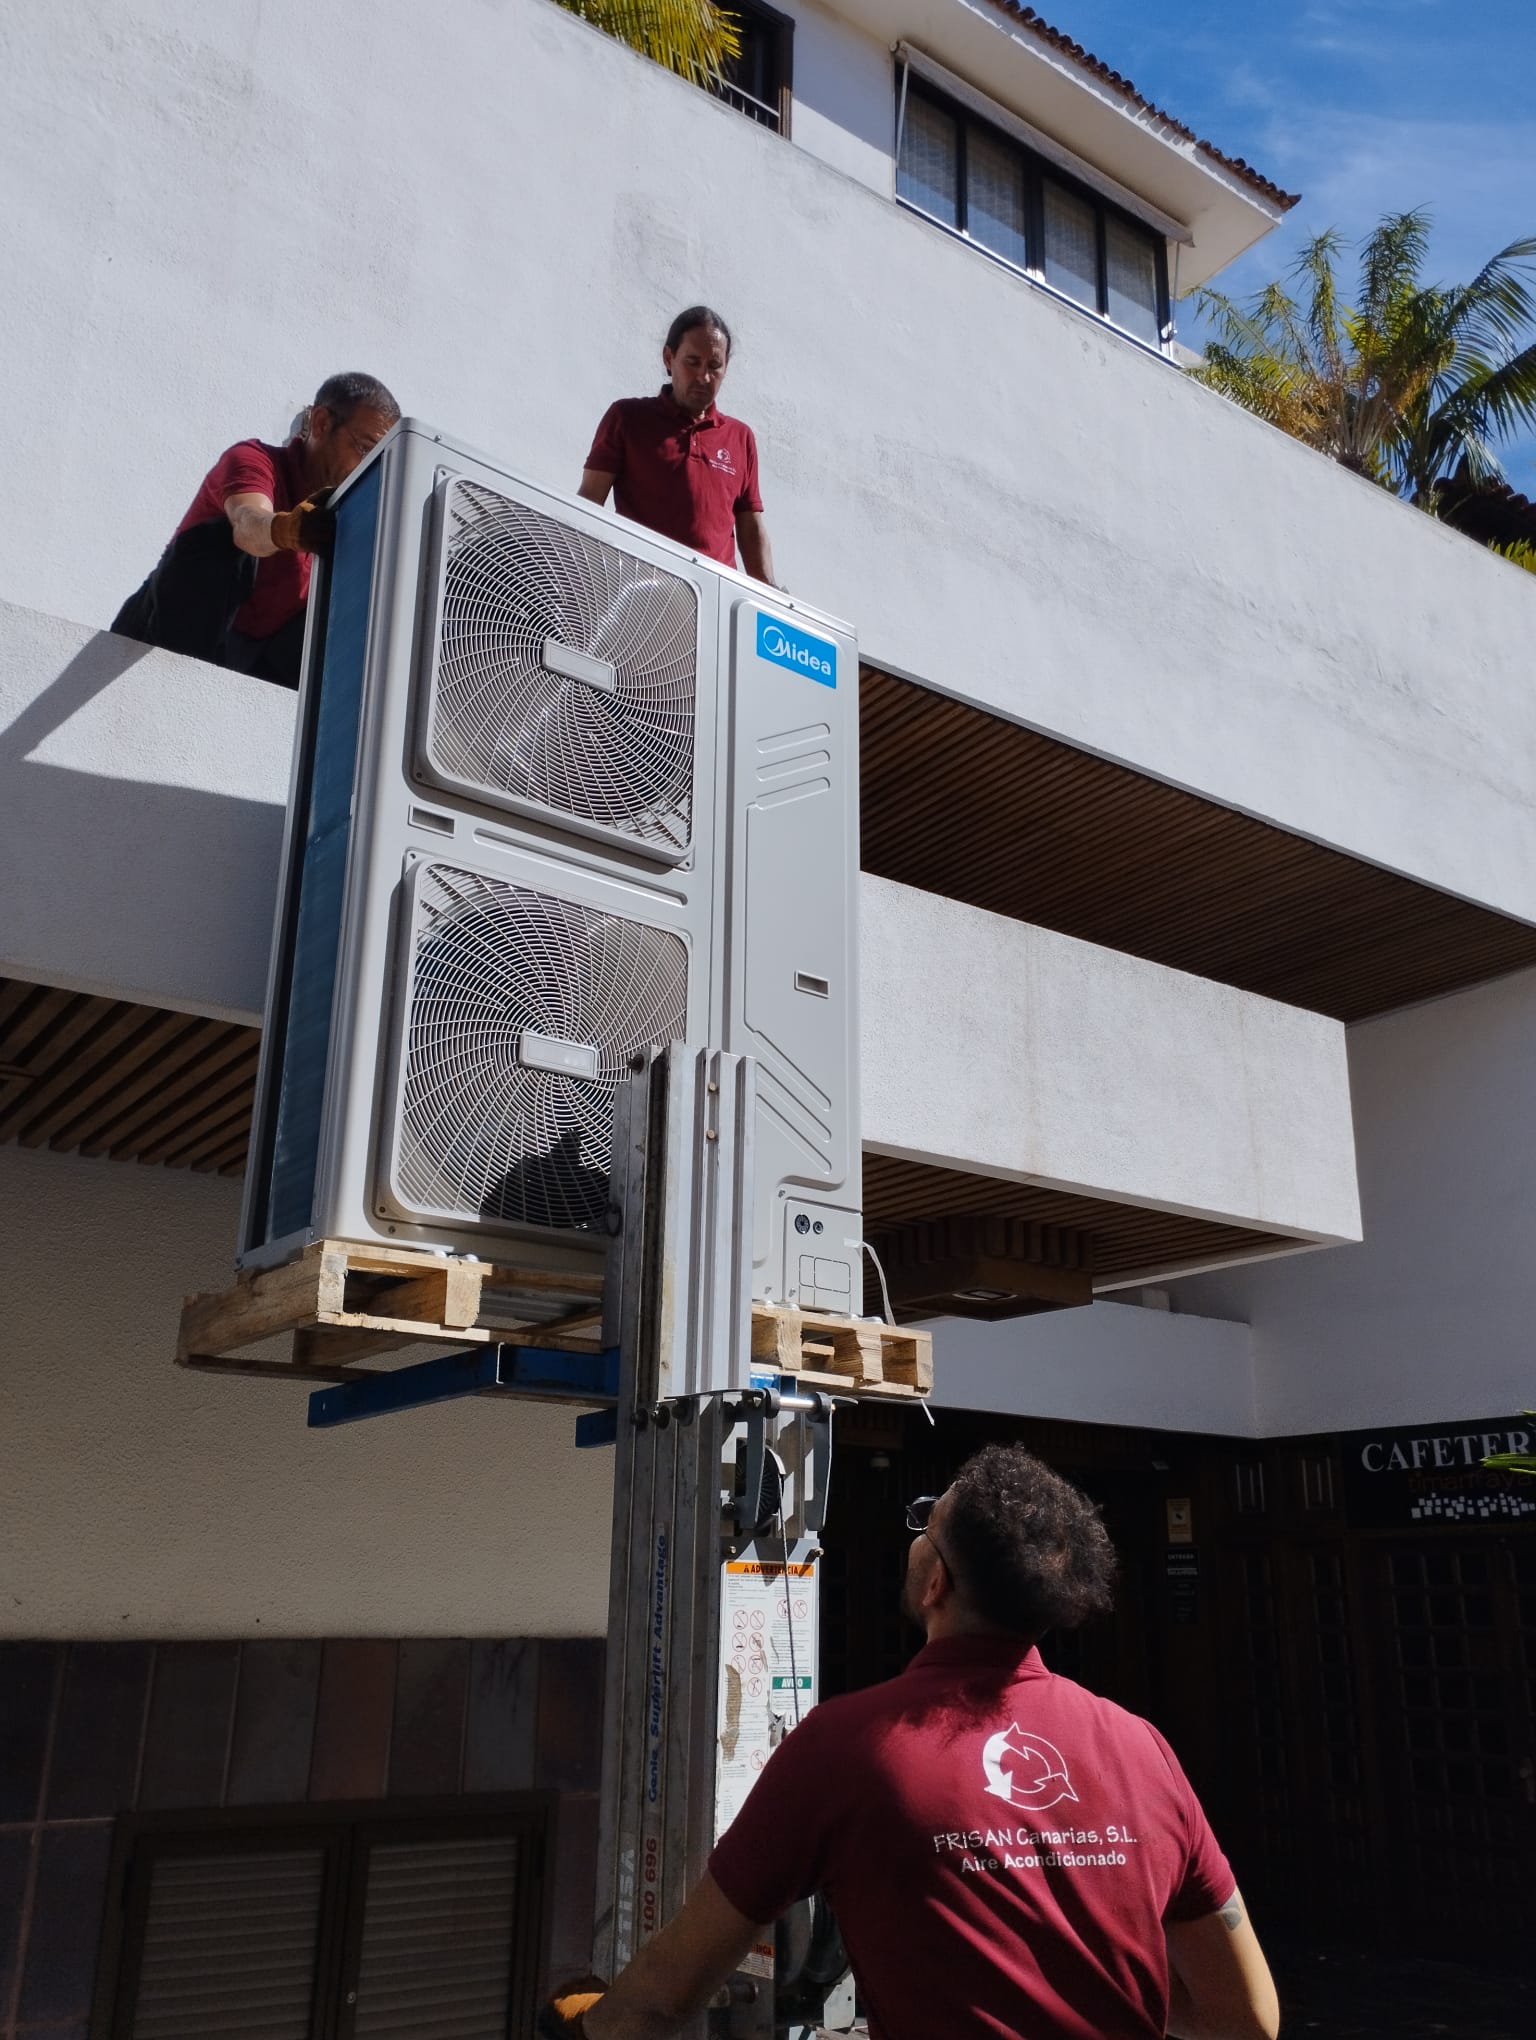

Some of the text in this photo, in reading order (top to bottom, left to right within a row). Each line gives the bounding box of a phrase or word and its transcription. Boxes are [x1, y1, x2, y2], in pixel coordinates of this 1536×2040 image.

[768, 634, 832, 676] Midea
[1361, 1431, 1535, 1472] CAFETER
[648, 1749, 659, 1802] Genie
[654, 1534, 666, 1639] Advantage
[781, 1677, 804, 1688] AVIO
[933, 1825, 1137, 1853] FRISAN Canarias, S.L.
[645, 1837, 657, 1883] 696
[961, 1850, 1126, 1873] Aire Acondicionado
